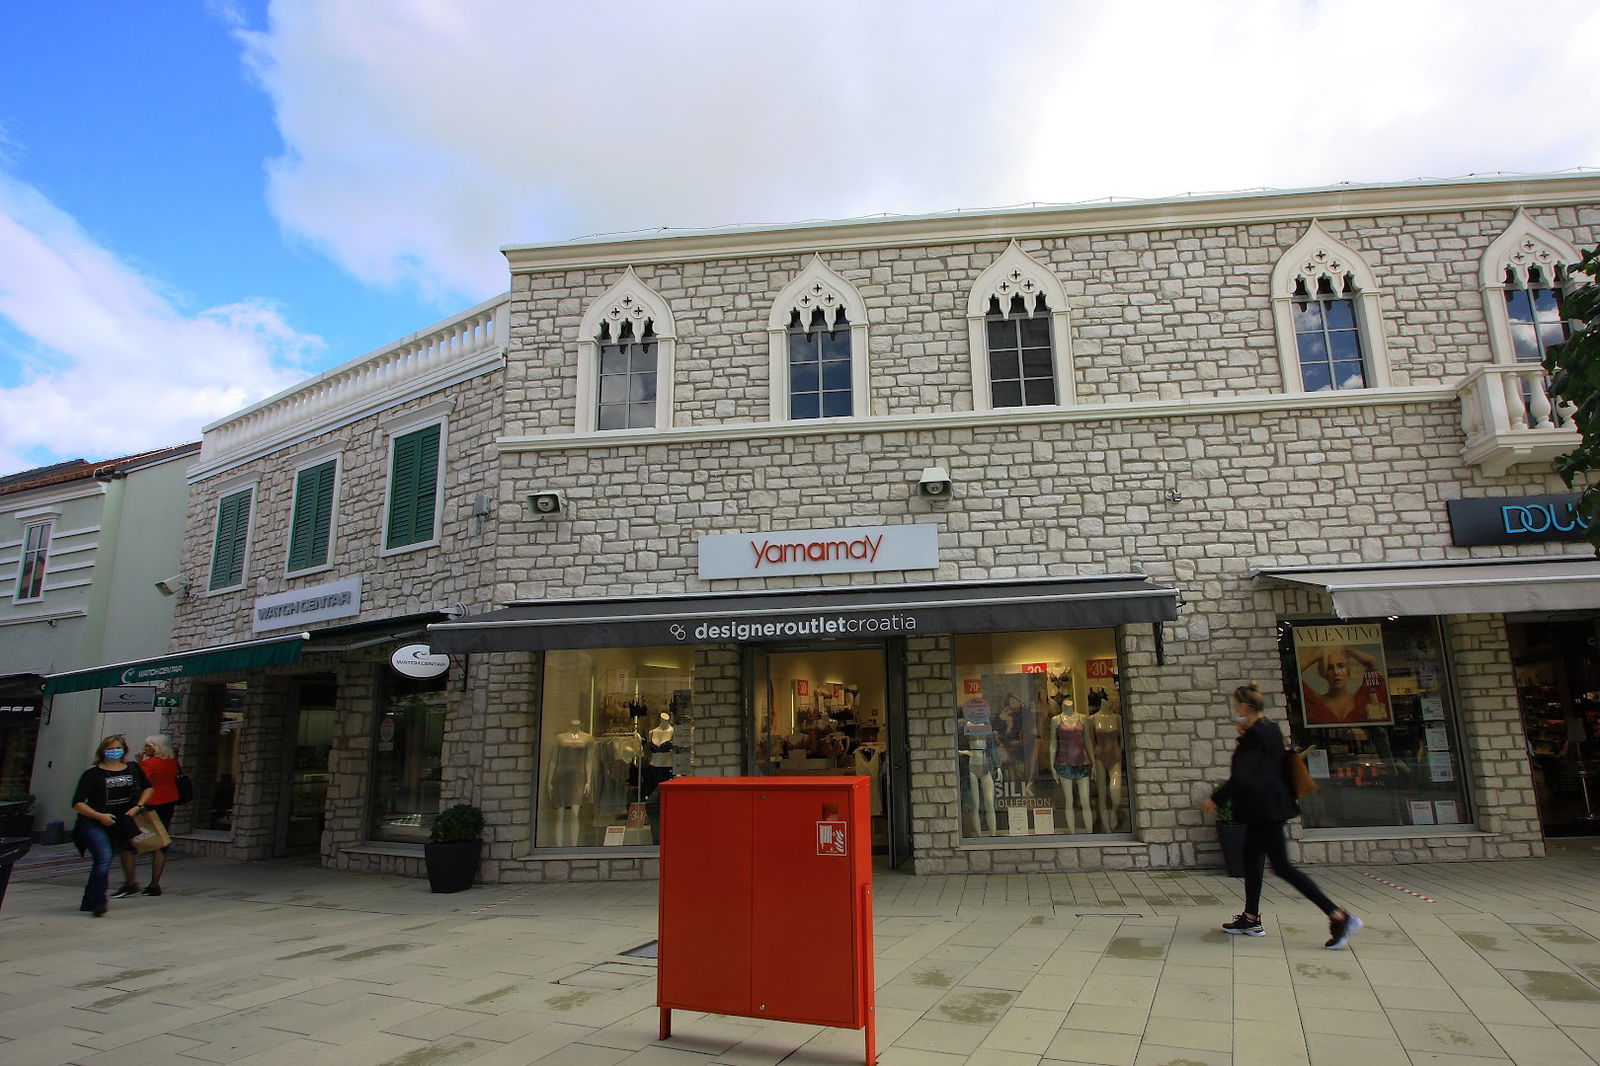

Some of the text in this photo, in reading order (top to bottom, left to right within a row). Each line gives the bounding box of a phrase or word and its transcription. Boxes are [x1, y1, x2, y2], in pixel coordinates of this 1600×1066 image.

[750, 534, 883, 568] yamamay
[257, 591, 351, 620] WATCH CENTAR
[694, 613, 917, 639] designeroutletcroatia
[1297, 627, 1380, 642] VALENTINO
[994, 781, 1034, 798] SILK
